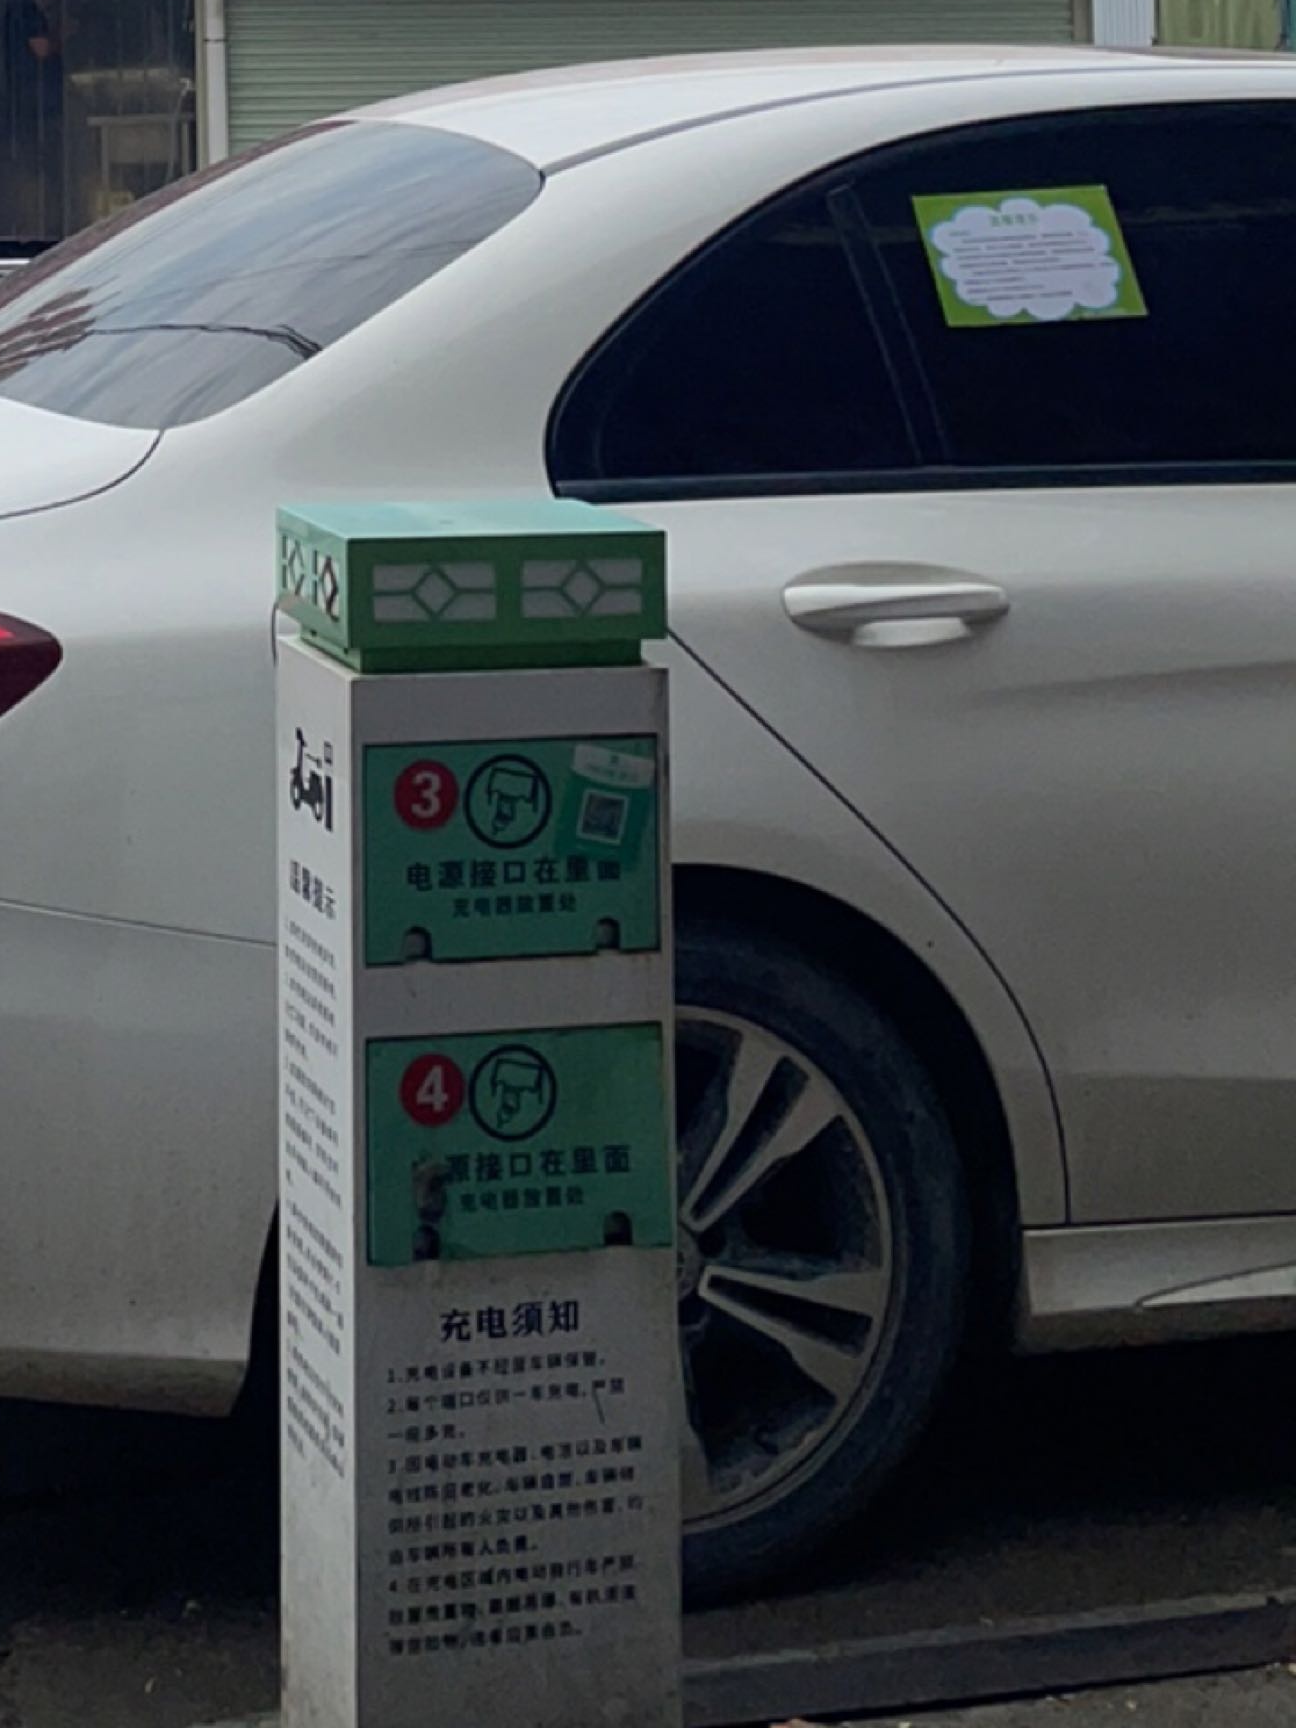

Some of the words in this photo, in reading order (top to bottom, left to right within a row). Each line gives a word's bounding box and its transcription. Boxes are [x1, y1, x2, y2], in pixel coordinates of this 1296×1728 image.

[410, 771, 442, 819] 3
[415, 1064, 448, 1111] 4
[439, 1299, 580, 1343] 充电须知
